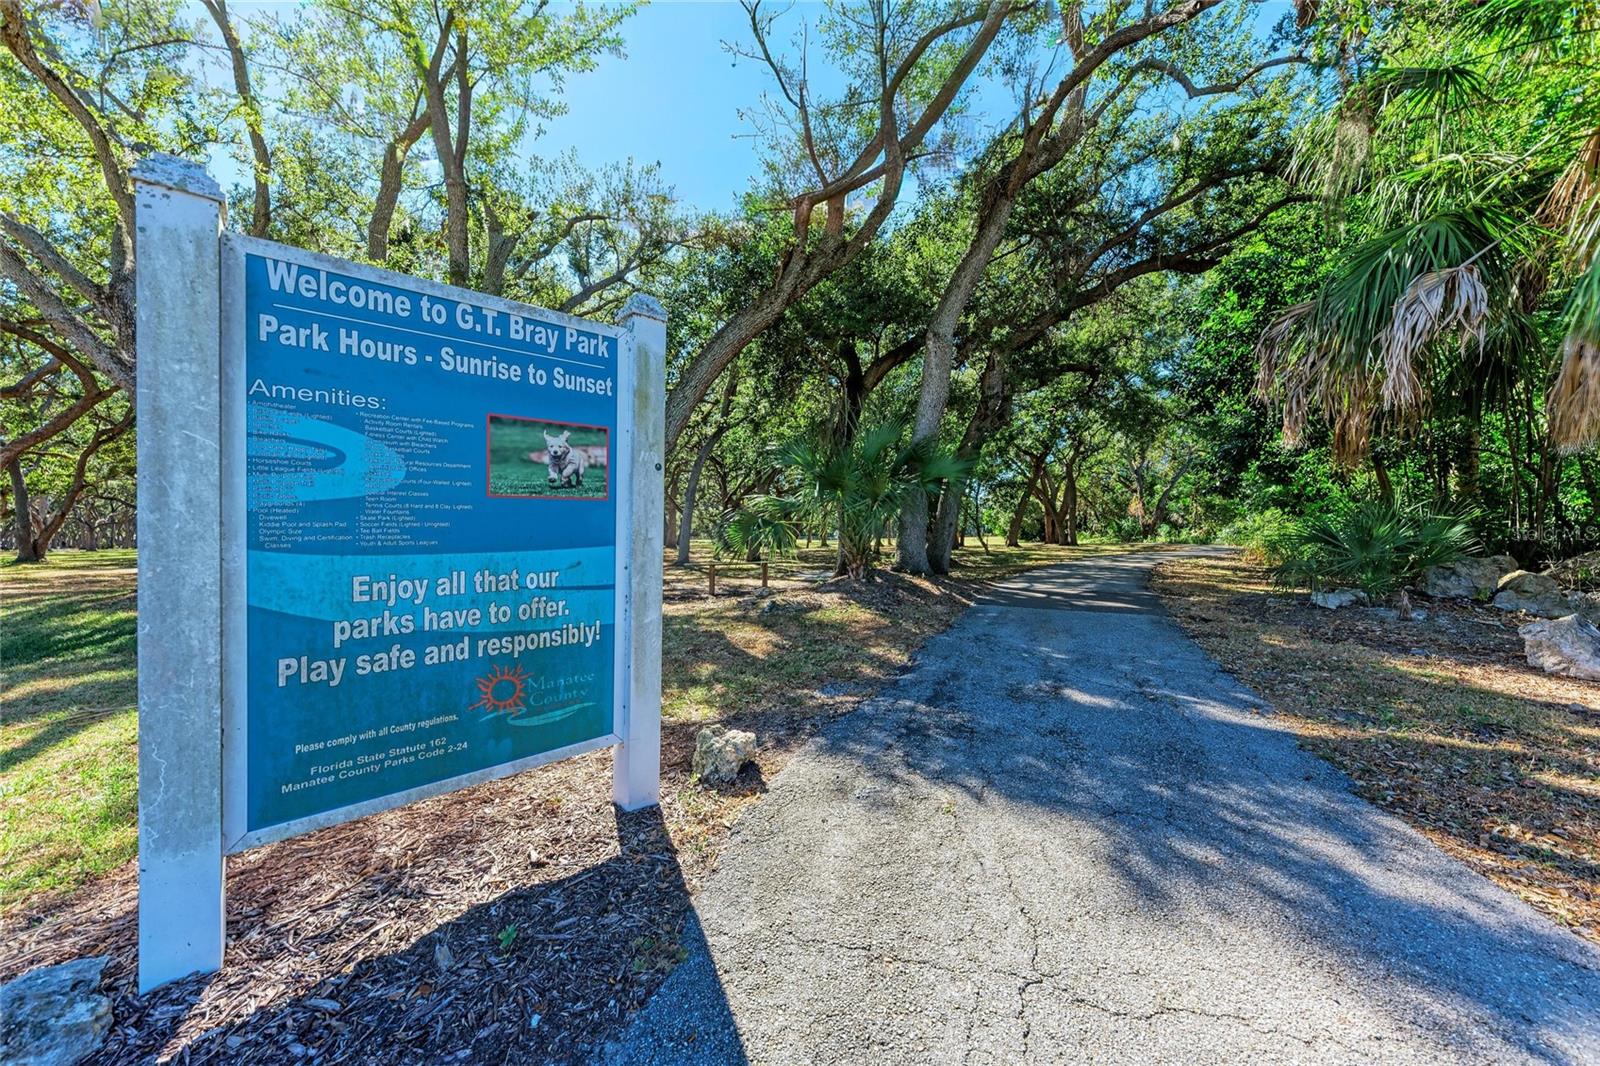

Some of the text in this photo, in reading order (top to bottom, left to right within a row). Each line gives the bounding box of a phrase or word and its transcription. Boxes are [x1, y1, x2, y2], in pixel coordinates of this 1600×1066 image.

[265, 258, 609, 359] Welcome to G.T. Bray Park
[259, 314, 329, 352] Park
[340, 328, 417, 366] Hours
[440, 347, 521, 383] Sunrise
[528, 363, 546, 386] to
[553, 366, 613, 397] Sunset
[249, 378, 387, 410] Amenities:
[451, 421, 474, 429] Programs
[352, 568, 559, 606] Enjoy all that our
[334, 598, 570, 648] parks have to offer.
[278, 621, 601, 688] Play safe and responsibly!
[527, 671, 596, 691] Manatee
[529, 688, 588, 707] County
[295, 713, 459, 754] Please comply with all County regulations.
[282, 742, 468, 794] Manatee County Parks Code 2-24
[311, 737, 447, 775] Florida State Statute 162
